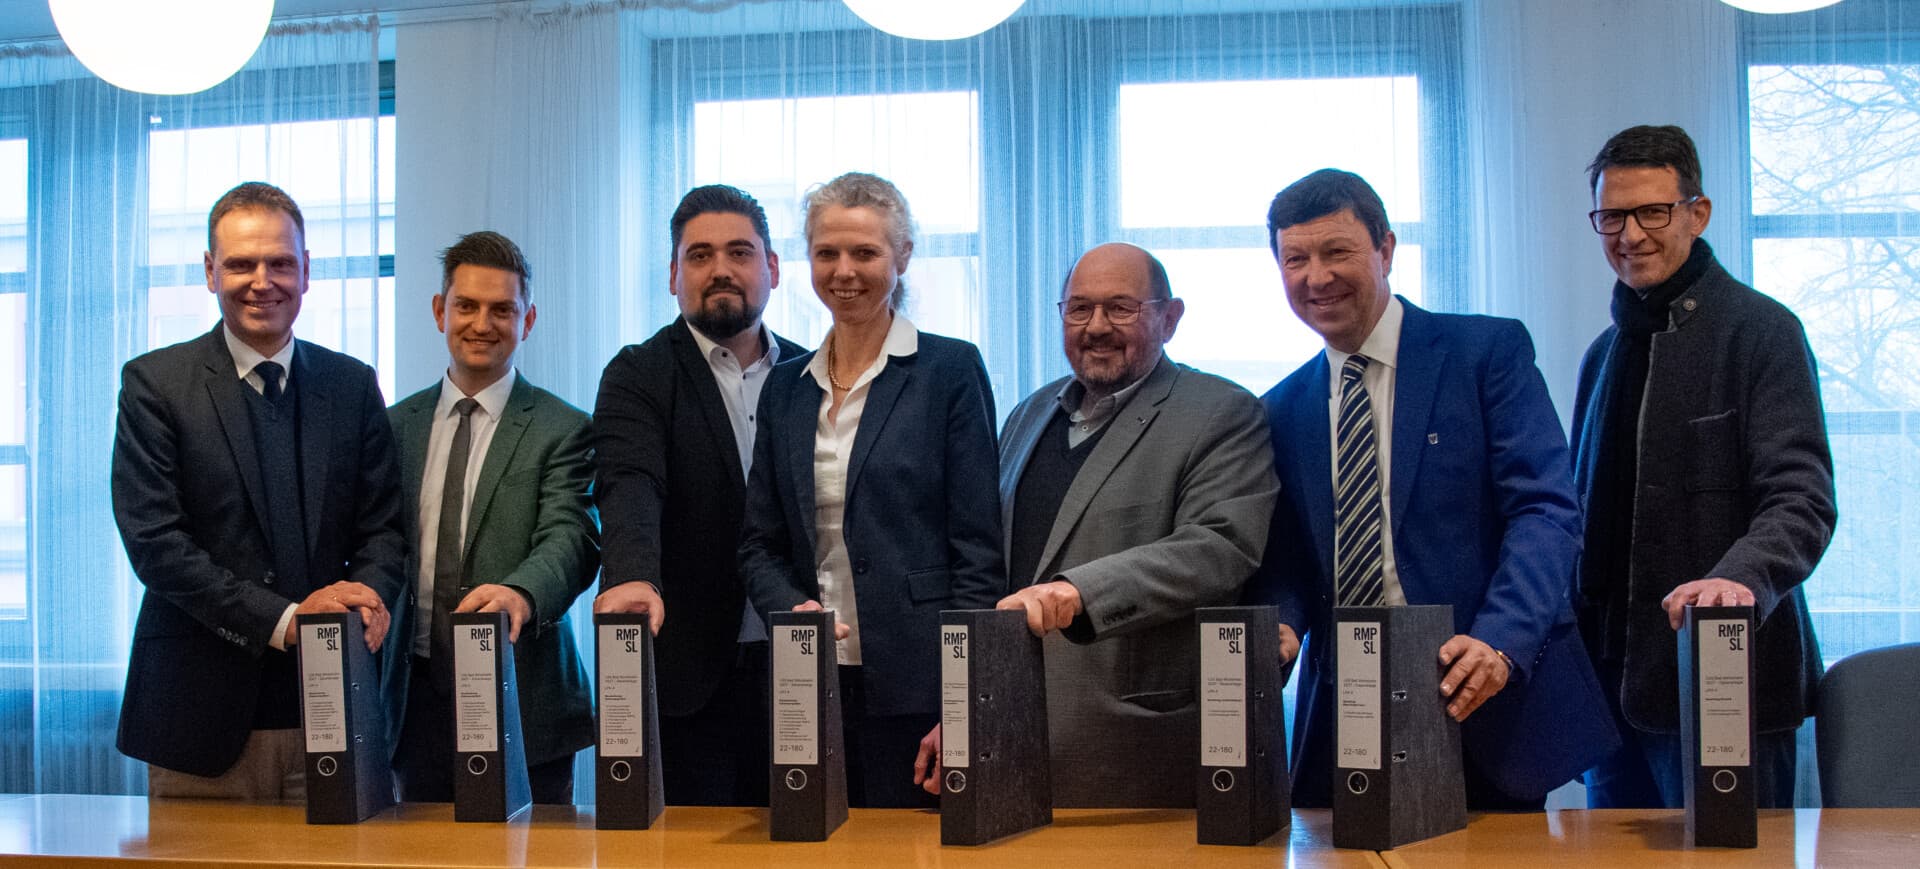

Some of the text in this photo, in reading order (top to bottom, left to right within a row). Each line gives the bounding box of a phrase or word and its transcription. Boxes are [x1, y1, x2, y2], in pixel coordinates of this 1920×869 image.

[317, 627, 339, 640] RMP
[471, 628, 493, 640] RMP
[616, 628, 639, 641] RMP
[791, 629, 815, 642] RMP
[1219, 627, 1243, 641] RMP
[1354, 627, 1377, 641] RMP
[1718, 624, 1745, 637] RMP
[327, 639, 339, 651] SL
[944, 632, 967, 646] RMP
[1729, 637, 1744, 651] SL
[480, 640, 492, 652] SL
[625, 641, 638, 653] SL
[801, 642, 814, 655] SL
[953, 646, 966, 659] SL
[1228, 641, 1242, 654] SL
[1363, 641, 1376, 654] SL
